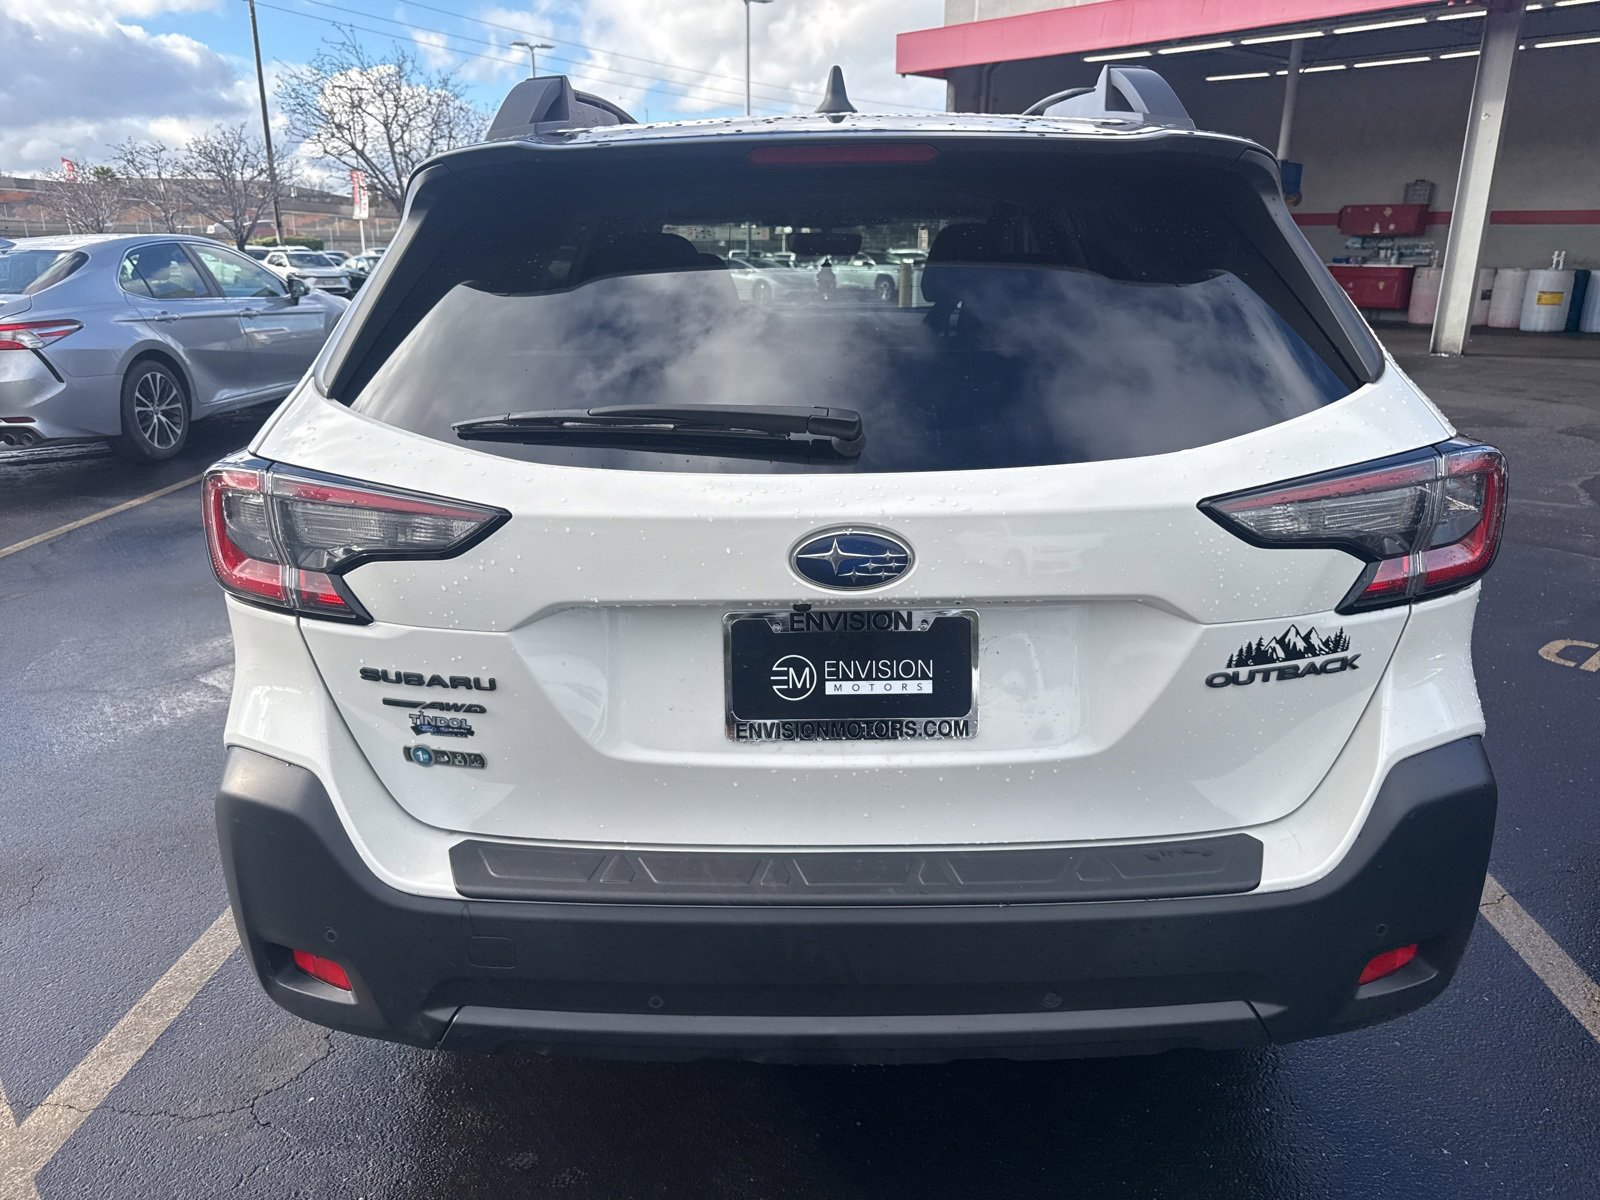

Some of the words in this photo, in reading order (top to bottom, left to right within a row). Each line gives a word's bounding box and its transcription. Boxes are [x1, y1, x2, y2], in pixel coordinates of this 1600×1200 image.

[789, 611, 913, 632] ENVISION
[359, 666, 497, 691] SUBARU
[824, 659, 934, 679] ENVISION
[1205, 653, 1361, 688] OUTBACK
[833, 682, 923, 692] MOTORS
[420, 701, 487, 714] AWD
[735, 719, 970, 739] ENVISIONMOTORS.COM
